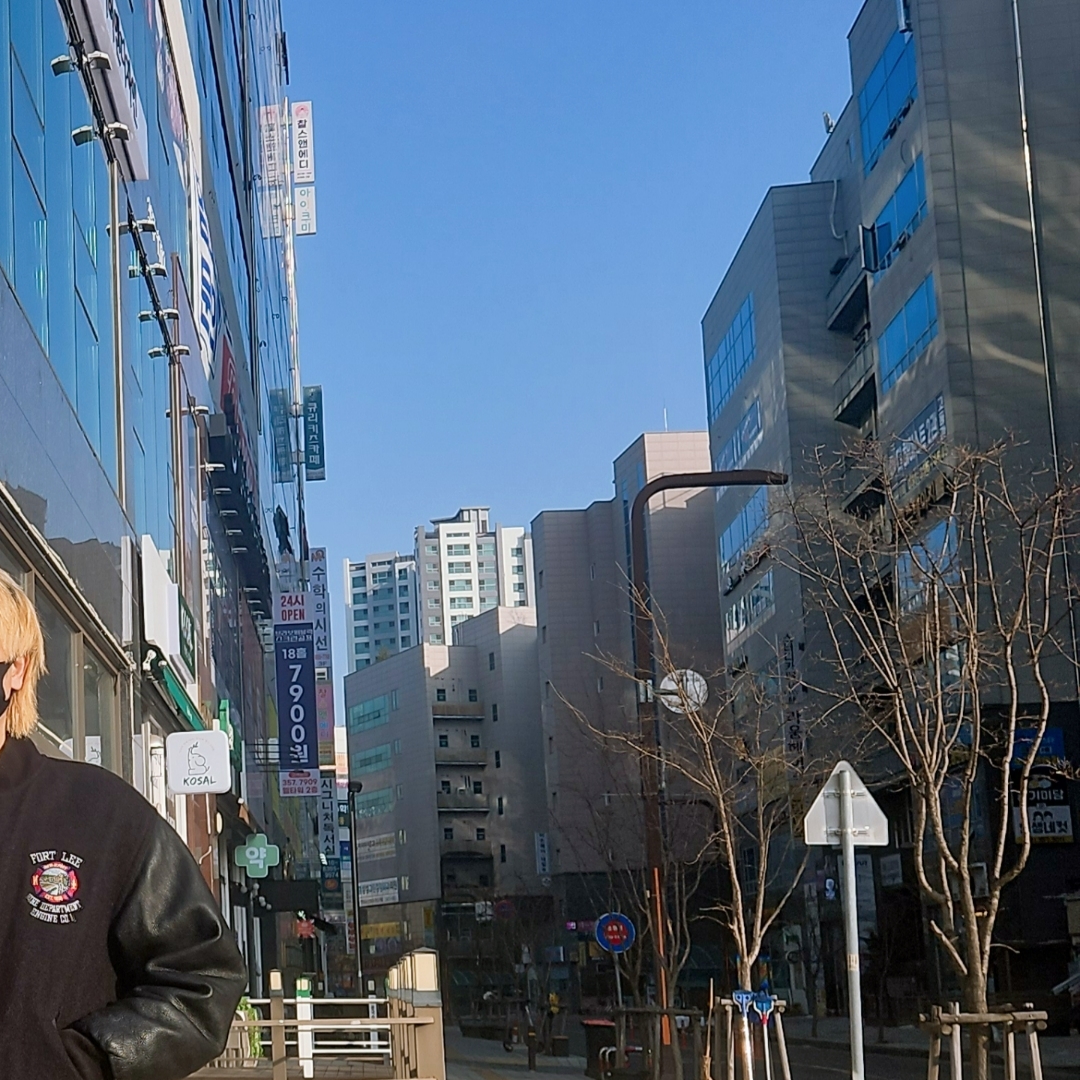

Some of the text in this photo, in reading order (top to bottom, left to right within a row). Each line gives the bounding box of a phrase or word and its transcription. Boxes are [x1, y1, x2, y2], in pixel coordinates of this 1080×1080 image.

[280, 594, 304, 607] 24시
[281, 609, 305, 621] OPEN
[311, 566, 328, 651] 수학의시선
[183, 776, 217, 787] KOSAL
[30, 850, 56, 865] FORT
[60, 851, 84, 868] LEE
[245, 847, 267, 869] 약
[39, 899, 82, 913] DEPARTMENT
[30, 908, 58, 923] ENGINE
